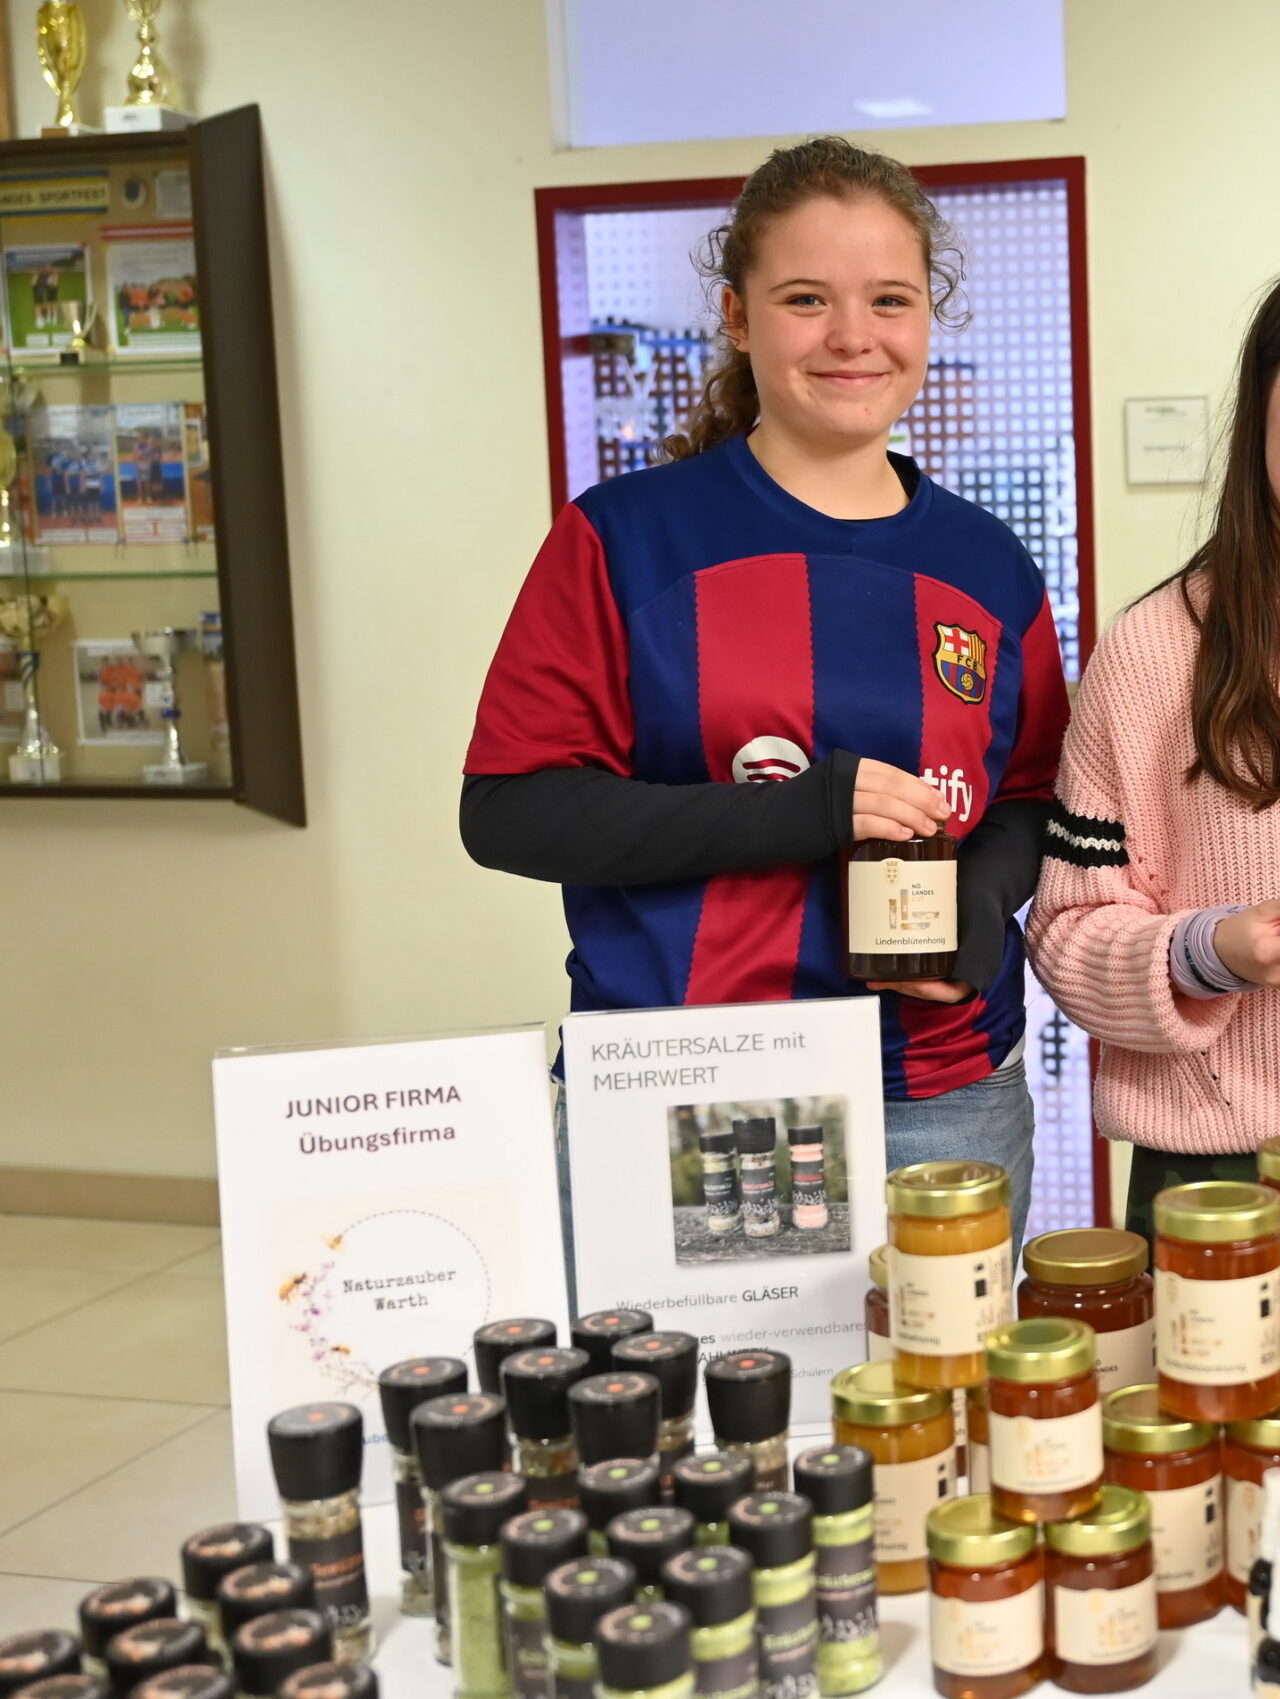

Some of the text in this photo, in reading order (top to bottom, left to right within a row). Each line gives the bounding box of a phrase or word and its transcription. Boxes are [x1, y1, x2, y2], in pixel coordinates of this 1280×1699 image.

[919, 765, 973, 822] tify
[591, 1031, 806, 1061] KRÄUTERSALZE mit
[593, 1065, 719, 1092] MEHRWERT
[285, 1085, 462, 1119] JUNIOR FIRMA
[299, 1125, 457, 1155] Übungsfirma
[343, 1269, 456, 1293] Naturzauber
[374, 1293, 429, 1311] Warth
[616, 1286, 799, 1313] Wiederbefüllbare GLÄSER
